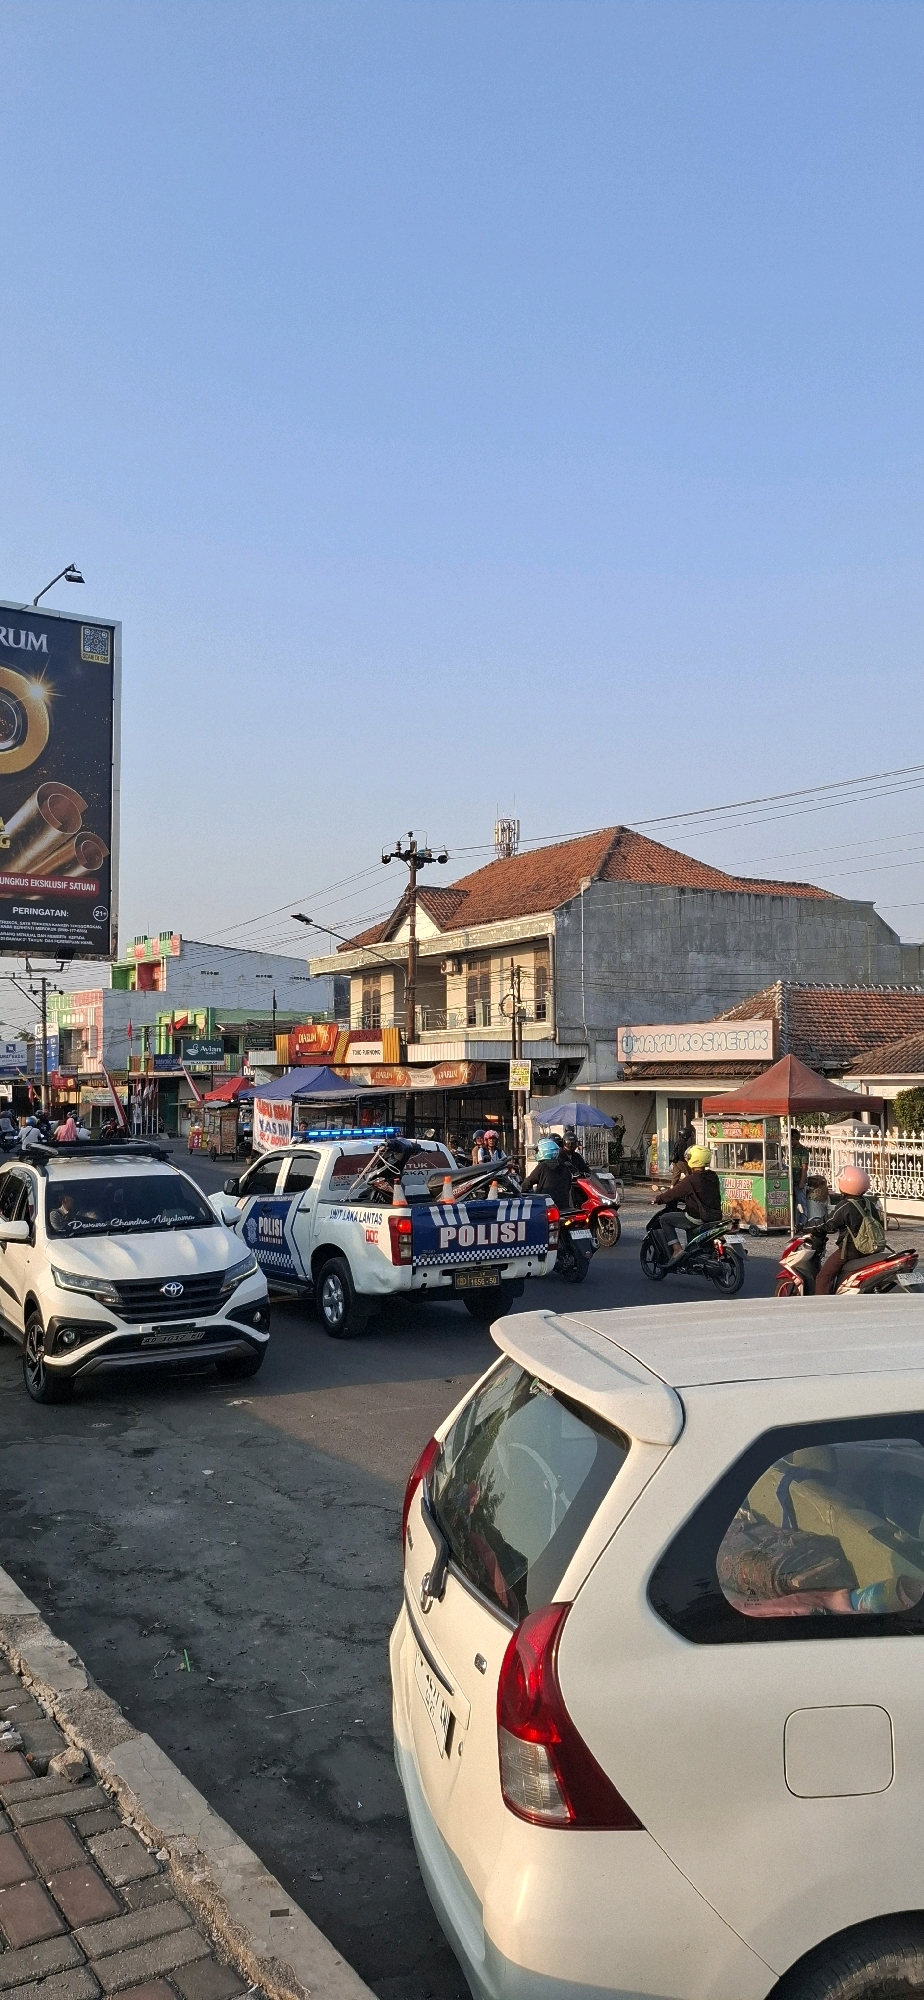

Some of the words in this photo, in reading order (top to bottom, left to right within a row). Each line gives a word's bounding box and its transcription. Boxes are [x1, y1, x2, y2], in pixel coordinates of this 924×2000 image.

[30, 878, 68, 889] EKSKLUSIF
[69, 882, 96, 892] SATUAN
[12, 906, 69, 917] PERINGATAN:
[622, 1034, 677, 1054] UWAYU
[679, 1030, 768, 1052] KOSMETIK
[342, 1209, 358, 1222] LAKA
[359, 1211, 382, 1225] LANTAS
[259, 1216, 283, 1237] POLISI
[440, 1221, 526, 1249] POLISI
